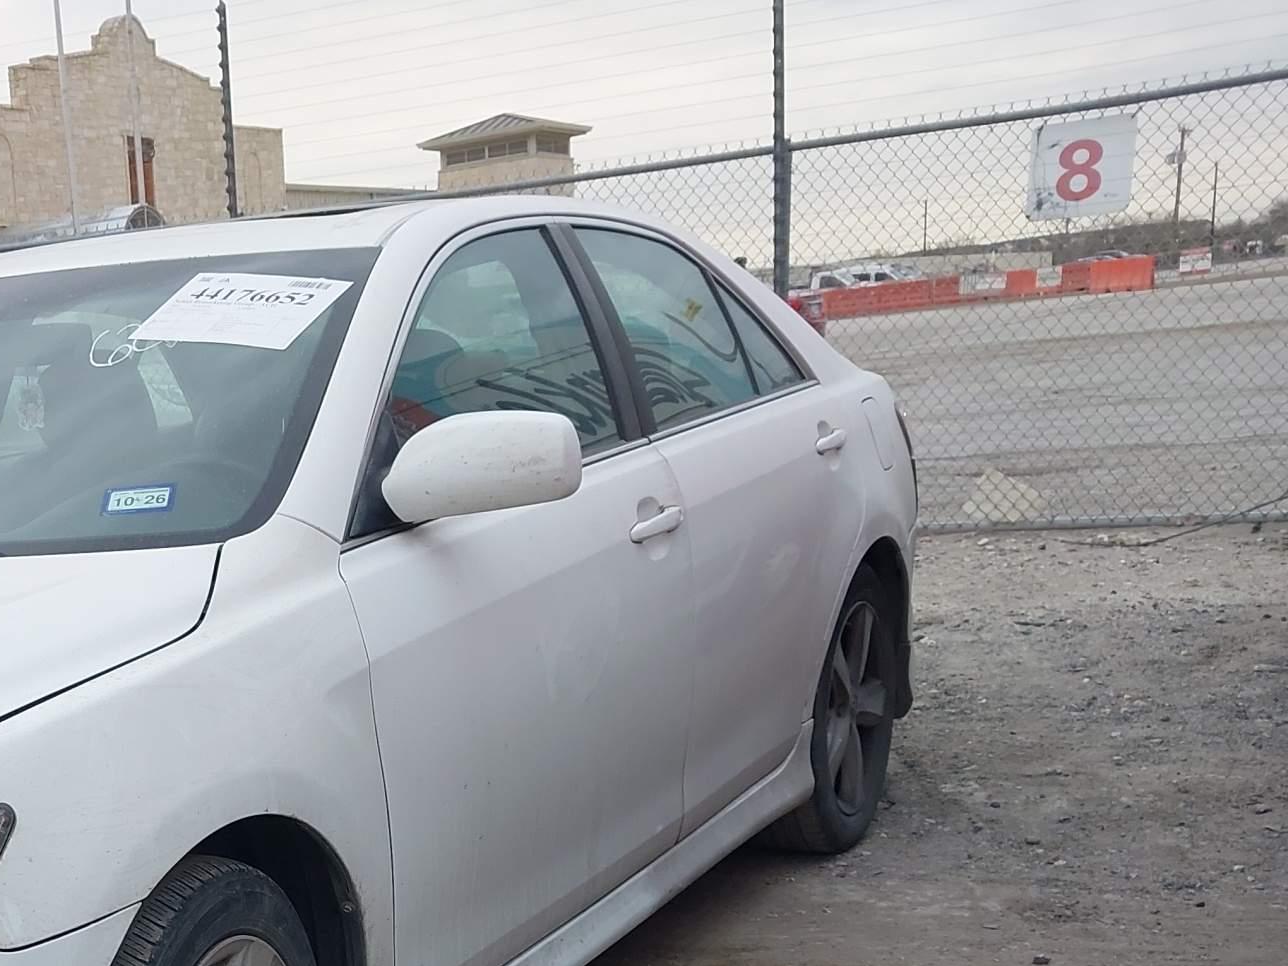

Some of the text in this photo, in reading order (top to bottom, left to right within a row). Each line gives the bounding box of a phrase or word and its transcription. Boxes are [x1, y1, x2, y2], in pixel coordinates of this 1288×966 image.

[1055, 138, 1104, 202] 8
[190, 287, 316, 306] 44176652
[114, 494, 167, 507] 10 26
